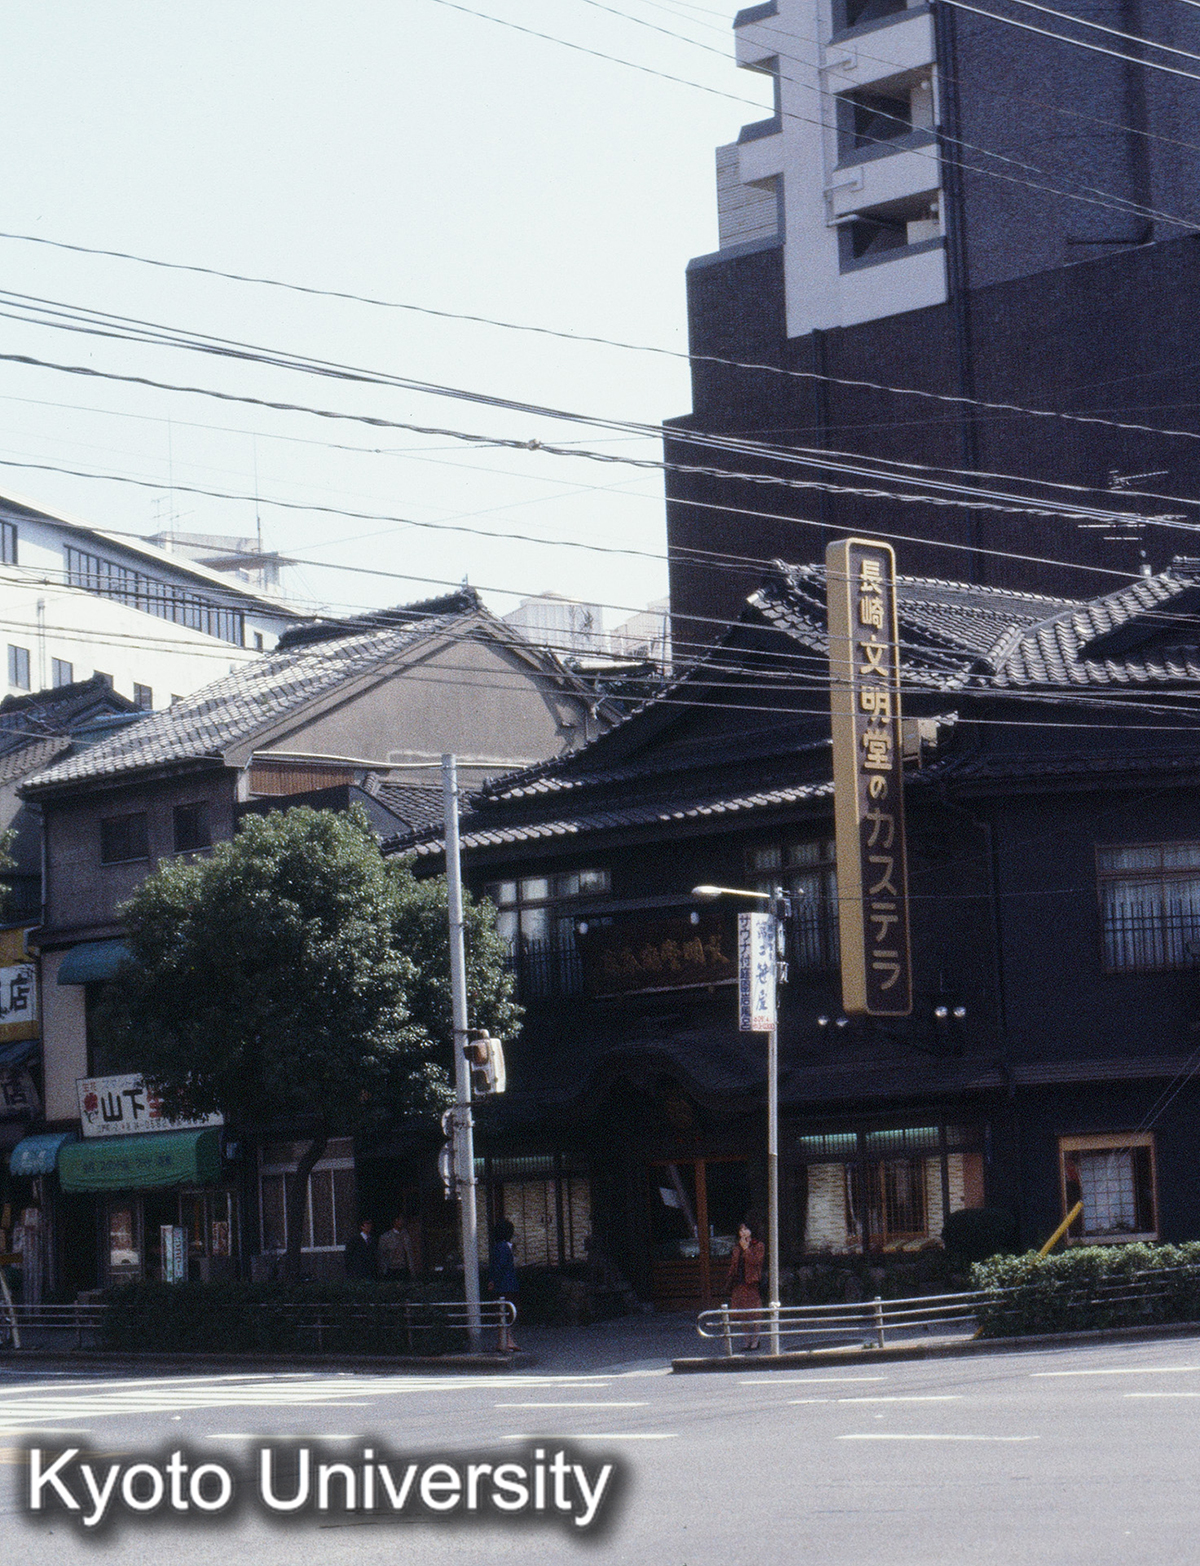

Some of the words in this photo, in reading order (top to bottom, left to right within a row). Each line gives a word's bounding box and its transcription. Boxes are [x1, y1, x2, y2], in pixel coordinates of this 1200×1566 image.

[860, 560, 901, 990] 長崎文明堂のカステラ
